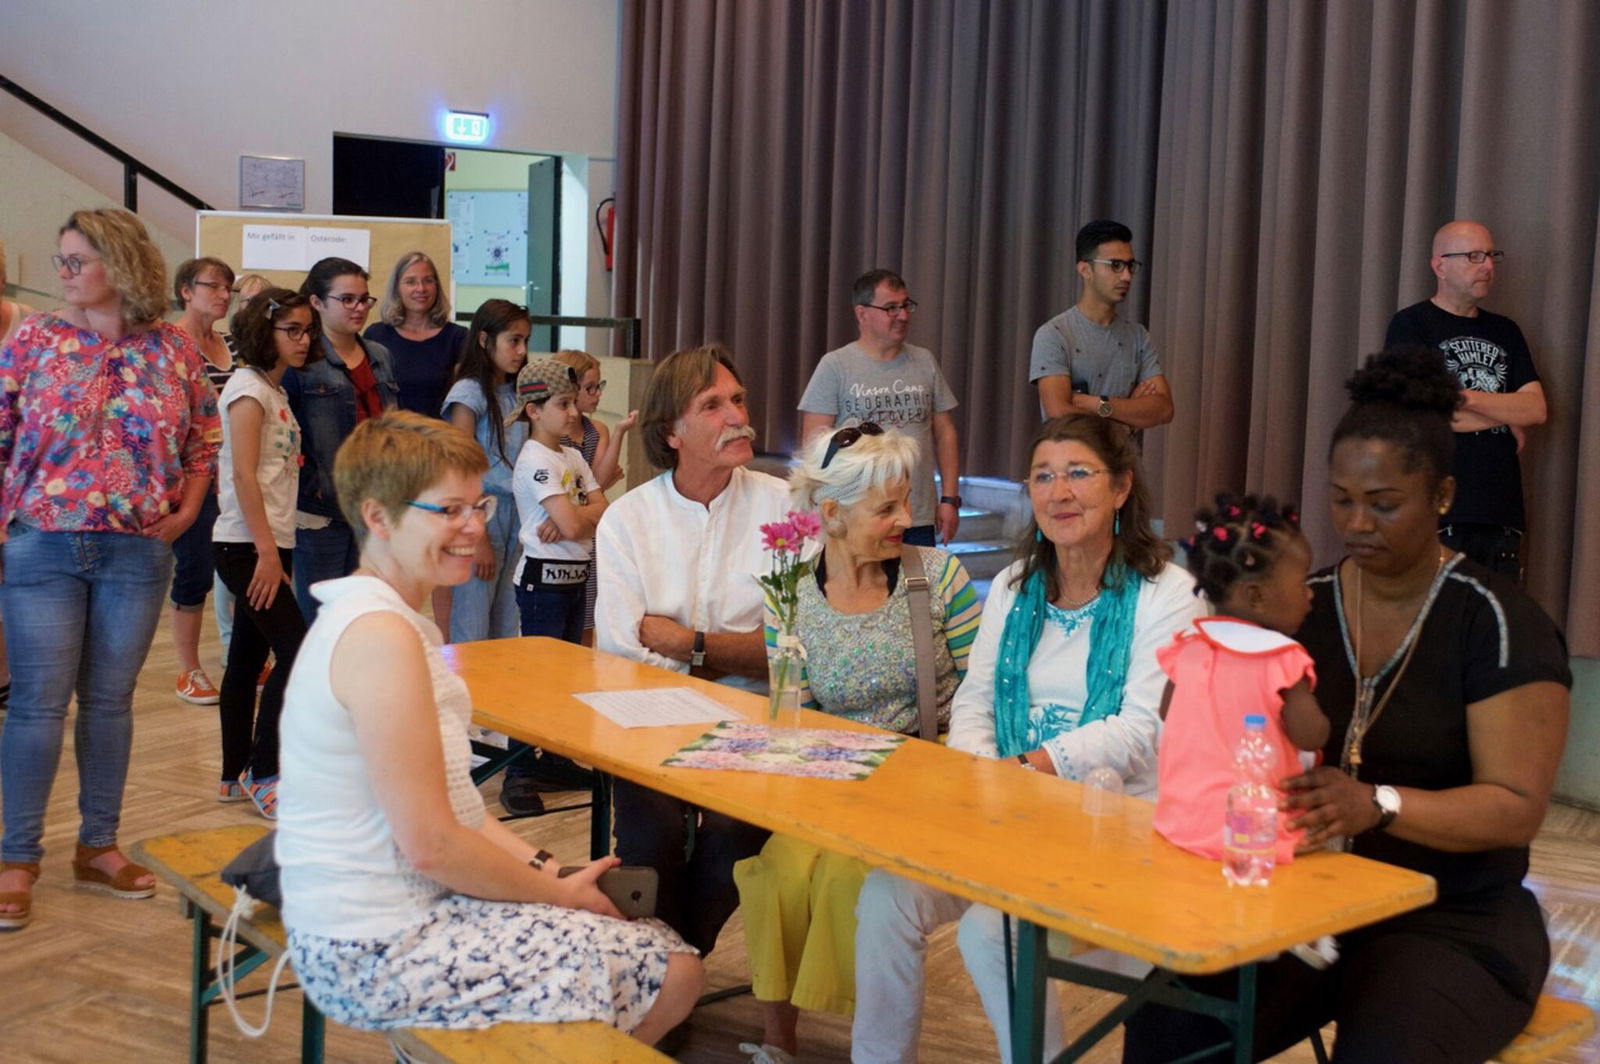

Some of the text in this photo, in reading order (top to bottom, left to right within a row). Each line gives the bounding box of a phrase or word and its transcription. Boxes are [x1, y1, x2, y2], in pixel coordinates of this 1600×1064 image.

[247, 232, 260, 240] Mir
[1449, 340, 1500, 358] SCATTERED
[1457, 351, 1496, 367] HAMLET
